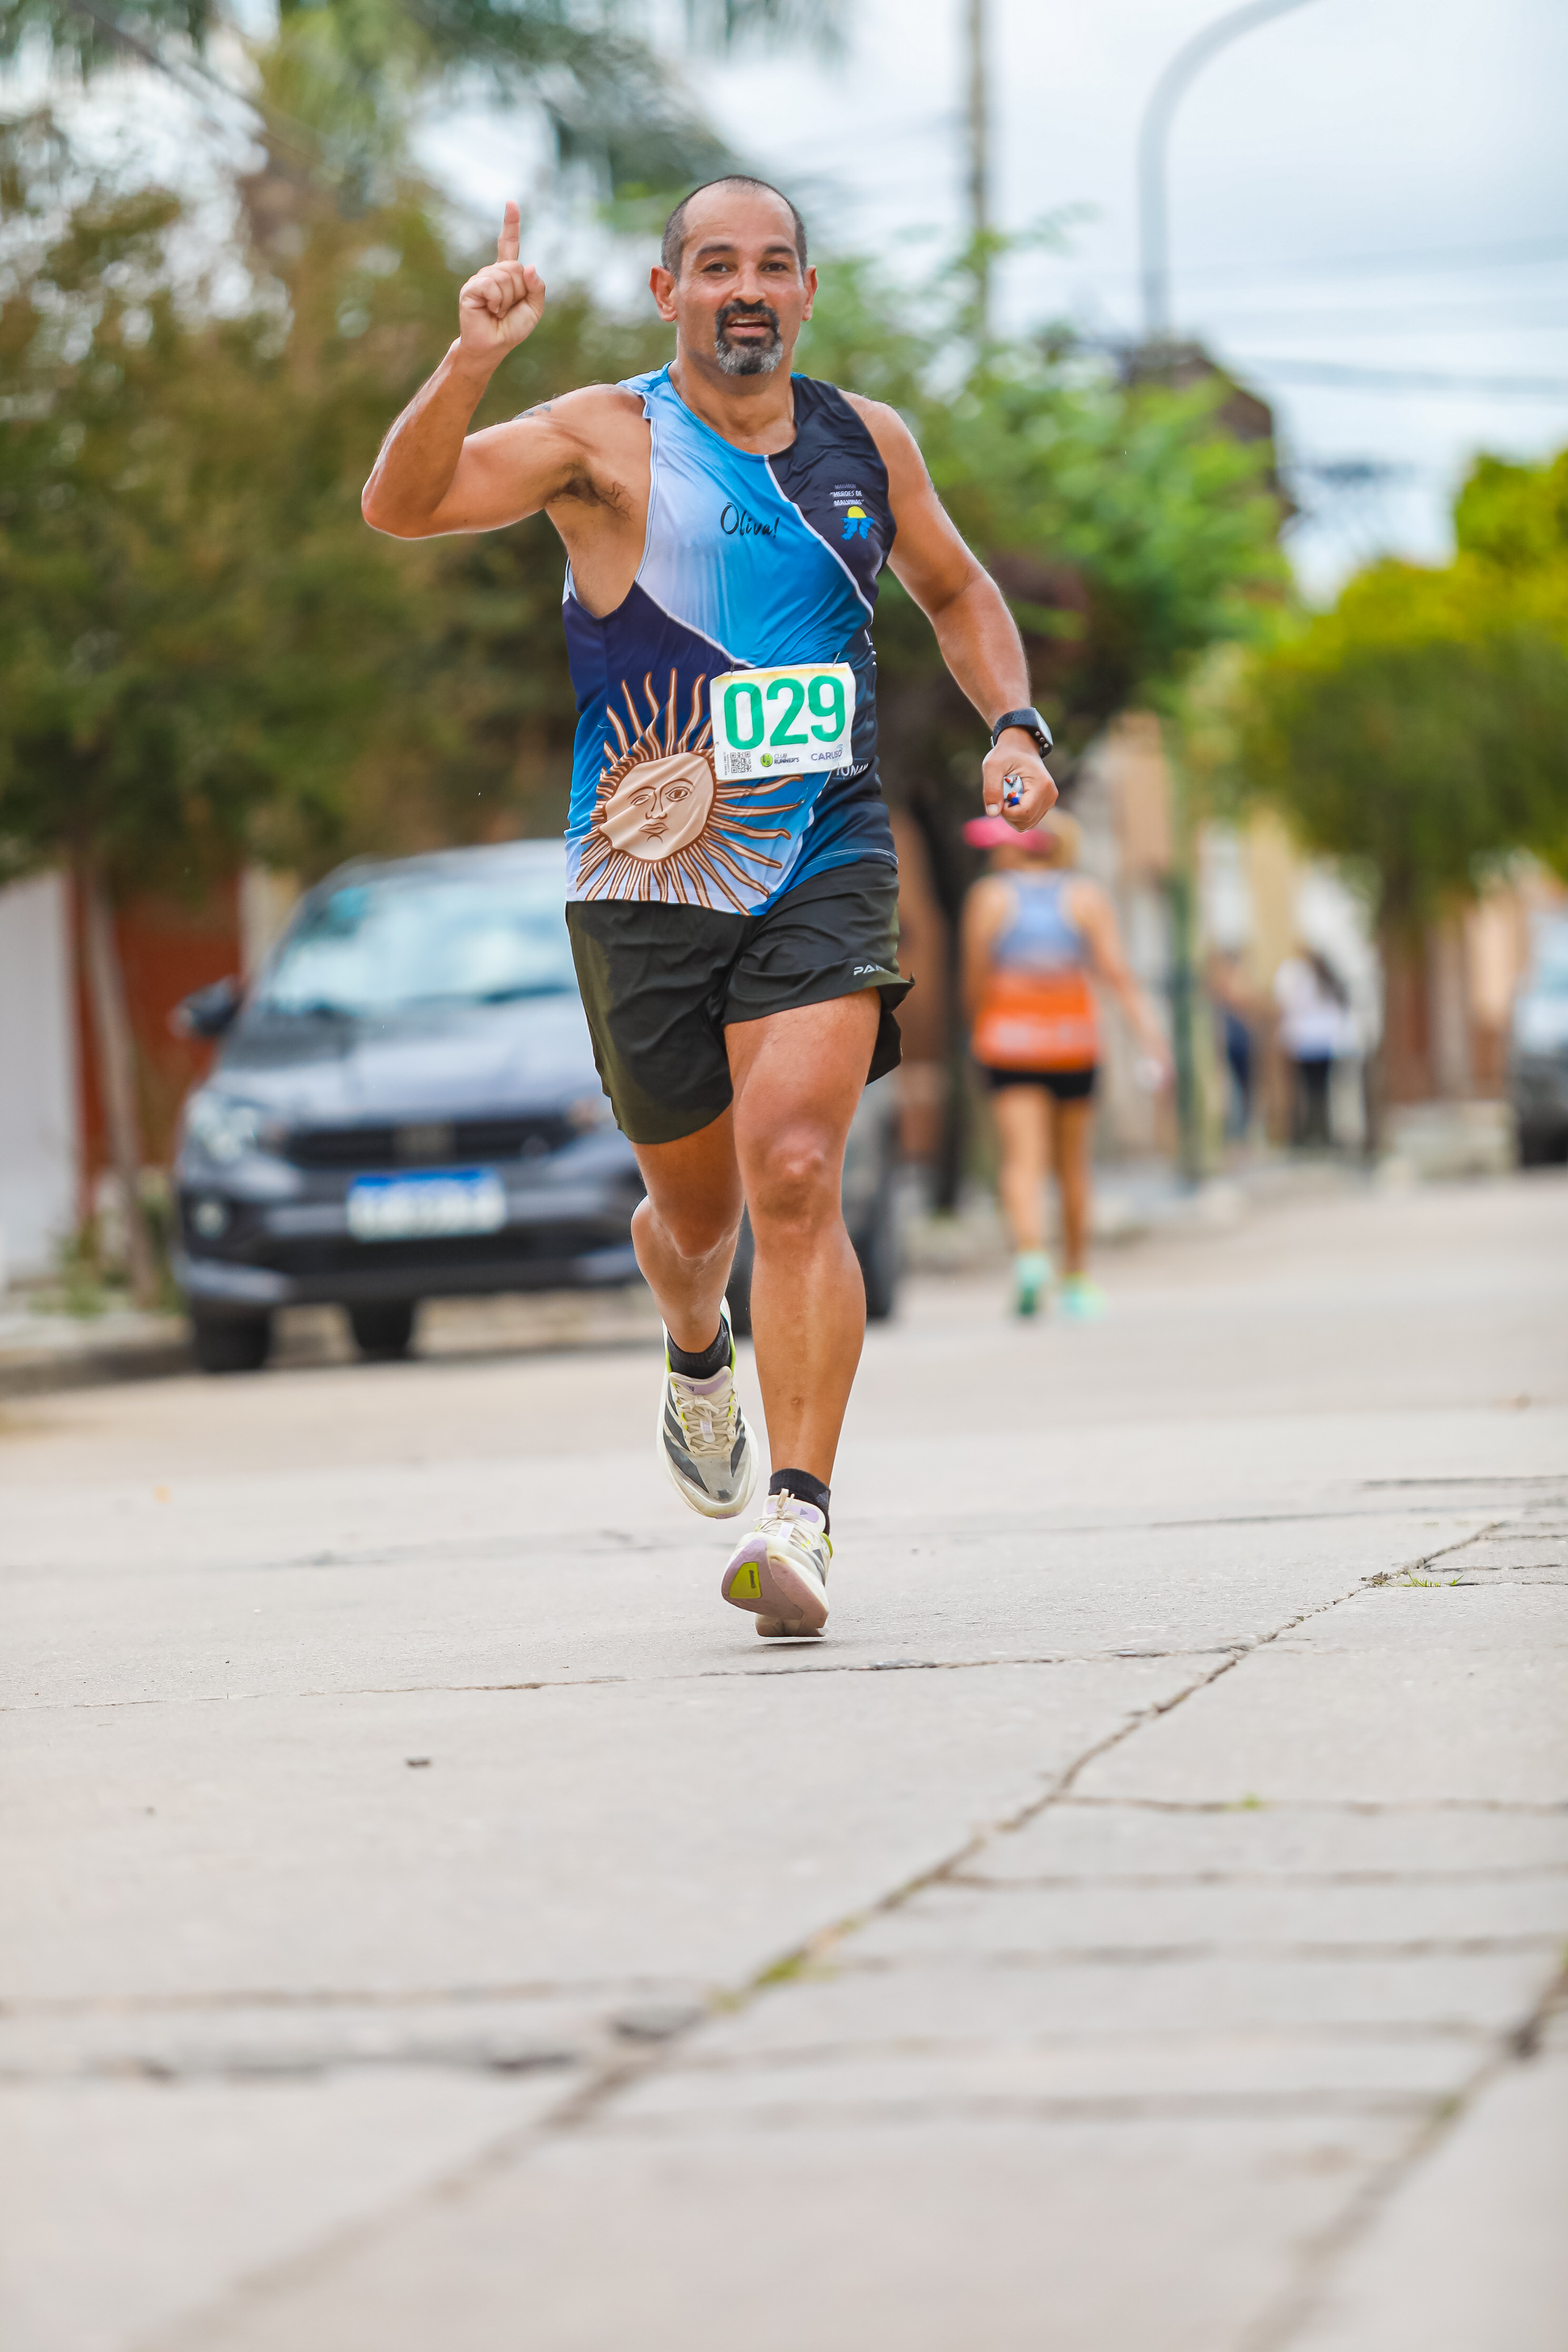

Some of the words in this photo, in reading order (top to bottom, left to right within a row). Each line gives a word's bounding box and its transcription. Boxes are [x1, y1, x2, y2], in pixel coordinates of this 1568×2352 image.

[720, 502, 780, 538] Oliva!
[724, 675, 845, 749] 029
[811, 749, 842, 761] CARUSO
